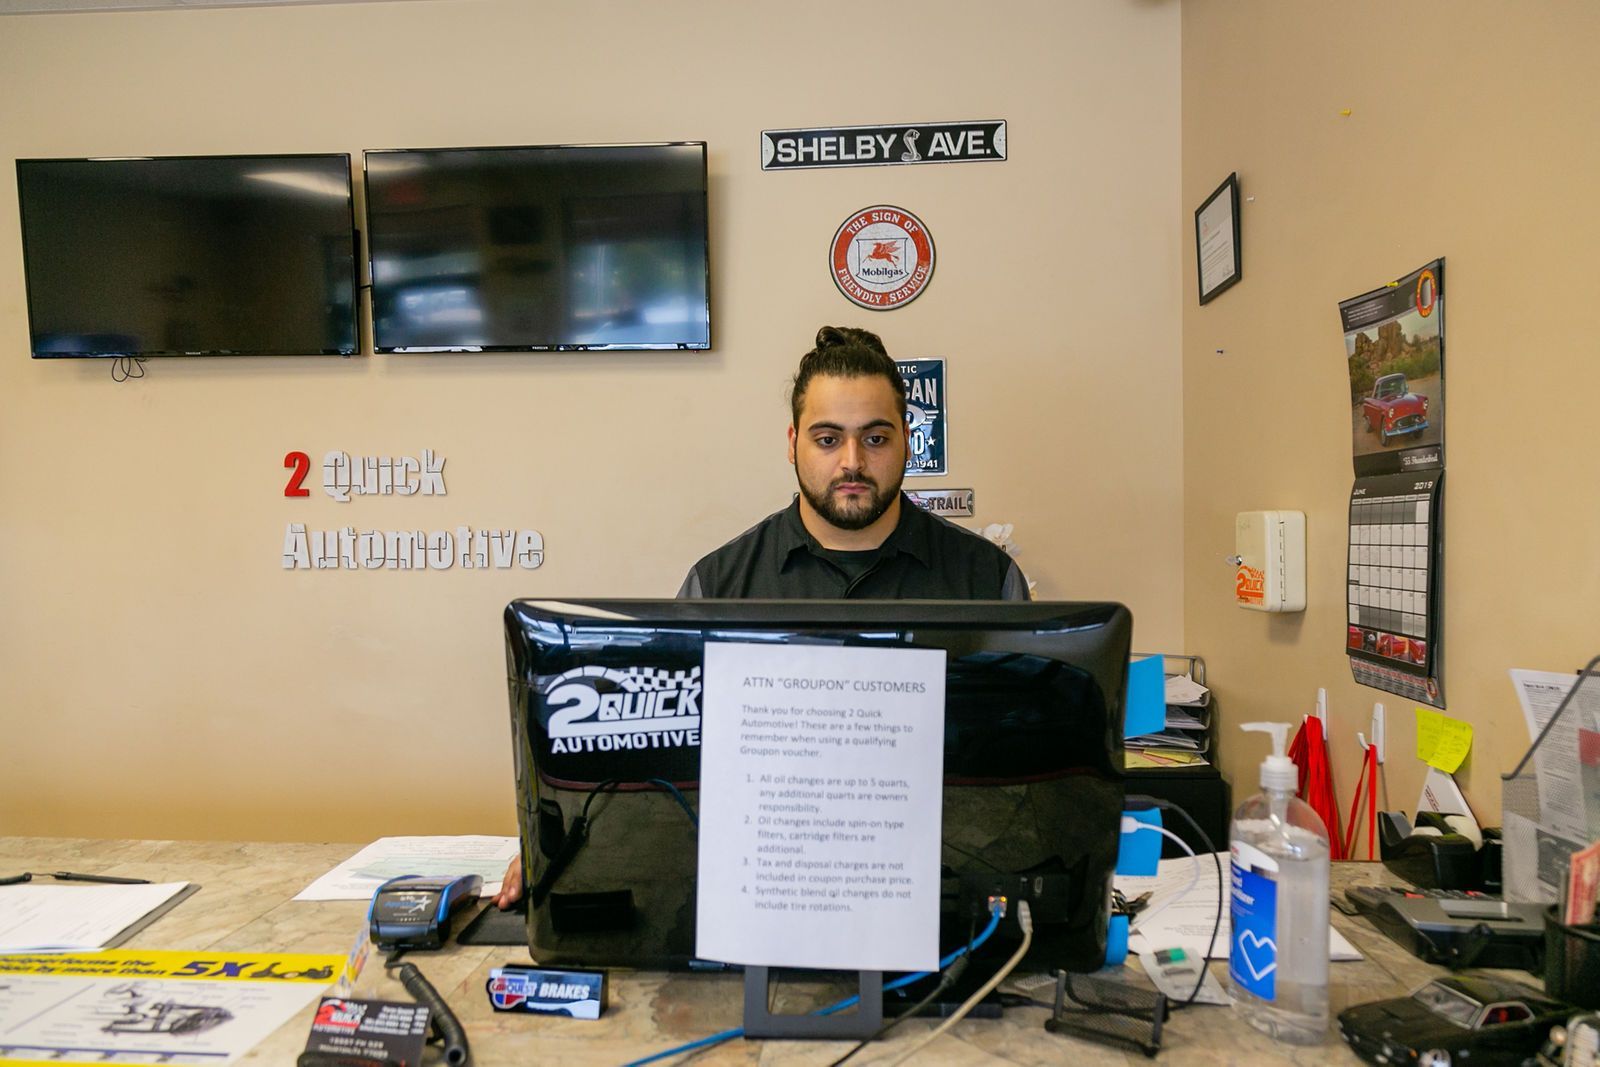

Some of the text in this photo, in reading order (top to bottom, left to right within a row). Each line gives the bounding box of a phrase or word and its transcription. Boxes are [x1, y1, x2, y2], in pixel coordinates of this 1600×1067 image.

[777, 130, 991, 162] SHELBY AVE.
[846, 211, 918, 235] THE SIGN OF
[861, 267, 904, 278] Mobilgas
[838, 265, 928, 304] FRIENDLY SERVICE
[284, 449, 447, 502] 2 Quick
[1414, 481, 1433, 490] 2019
[928, 496, 966, 510] TRAIL
[282, 522, 545, 570] Automotive
[743, 677, 774, 688] ATTN
[854, 680, 926, 693] CUSTOMERS
[598, 690, 701, 720] QUICK
[742, 705, 882, 719] Thank you for choosing 2 Quick
[741, 719, 798, 729] Automotive!
[801, 721, 830, 730] These
[833, 723, 844, 731] are
[854, 722, 871, 731] few
[874, 723, 901, 734] things
[904, 725, 913, 733] to
[552, 730, 701, 754] AUTOMOTIVE
[741, 733, 788, 743] remember
[791, 734, 815, 744] when
[818, 736, 842, 746] using
[852, 736, 896, 748] qualifying
[740, 746, 822, 758] Groupon voucher.
[761, 774, 771, 783] All
[775, 775, 785, 784] oil
[788, 776, 824, 787] changes
[845, 779, 855, 788] up
[858, 778, 868, 786] to
[871, 778, 875, 787] 5
[878, 779, 910, 789] quarts,
[760, 789, 908, 801] any additional quarts are owners
[759, 802, 822, 814] responsibility.
[744, 816, 904, 830] 2. Oil changes include spin-on type
[758, 830, 875, 843] filters, cartridge filters are
[758, 844, 805, 854] additional.
[743, 857, 750, 865] 3.
[757, 858, 772, 867] Tax
[775, 859, 792, 868] and
[795, 859, 831, 871] disposal
[834, 860, 869, 871] charges
[889, 861, 903, 870] not
[756, 871, 914, 886] included in coupon purchase price.
[742, 886, 911, 900] 4. Synthetic blend oil changes do not
[755, 900, 853, 912] include tire rotations.
[170, 961, 258, 977] 5X
[538, 983, 590, 1000] BRAKES
